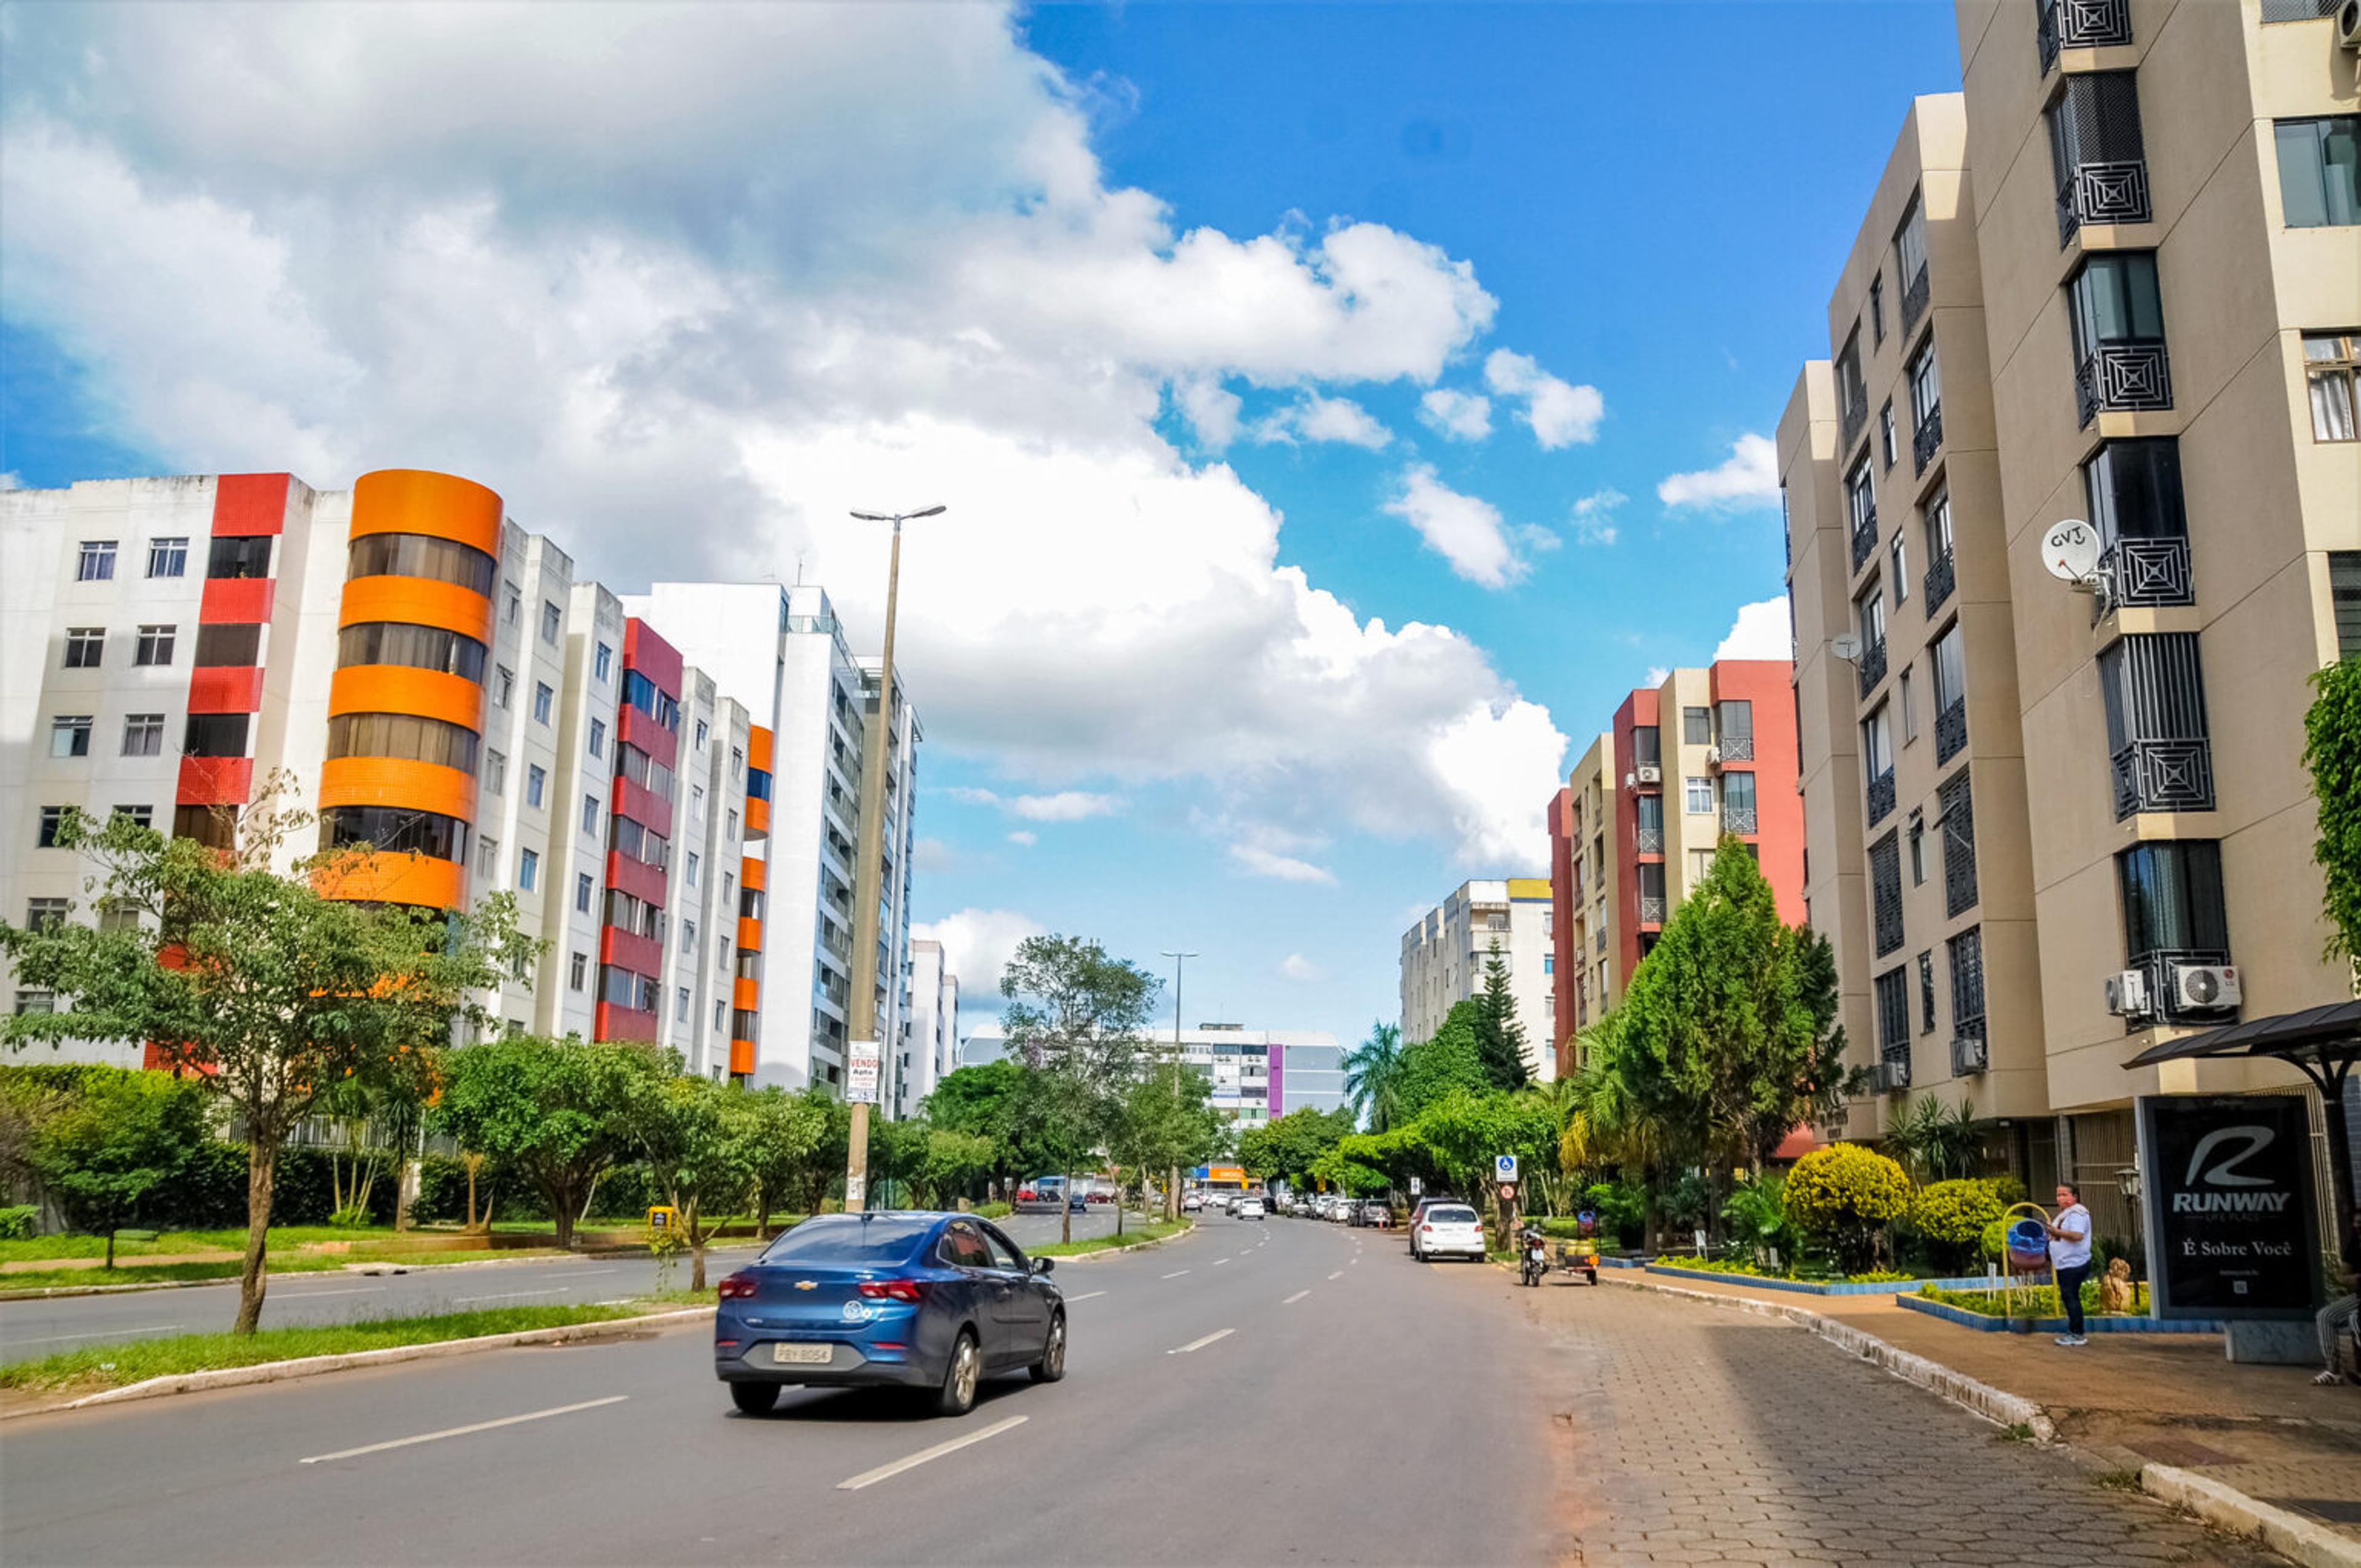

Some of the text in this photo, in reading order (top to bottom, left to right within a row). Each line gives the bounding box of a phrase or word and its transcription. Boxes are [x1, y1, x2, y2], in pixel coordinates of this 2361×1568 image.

[850, 1058, 879, 1068] VENDO
[2172, 1192, 2292, 1213] RUNWAY
[2183, 1237, 2293, 1256] É Sobre Você
